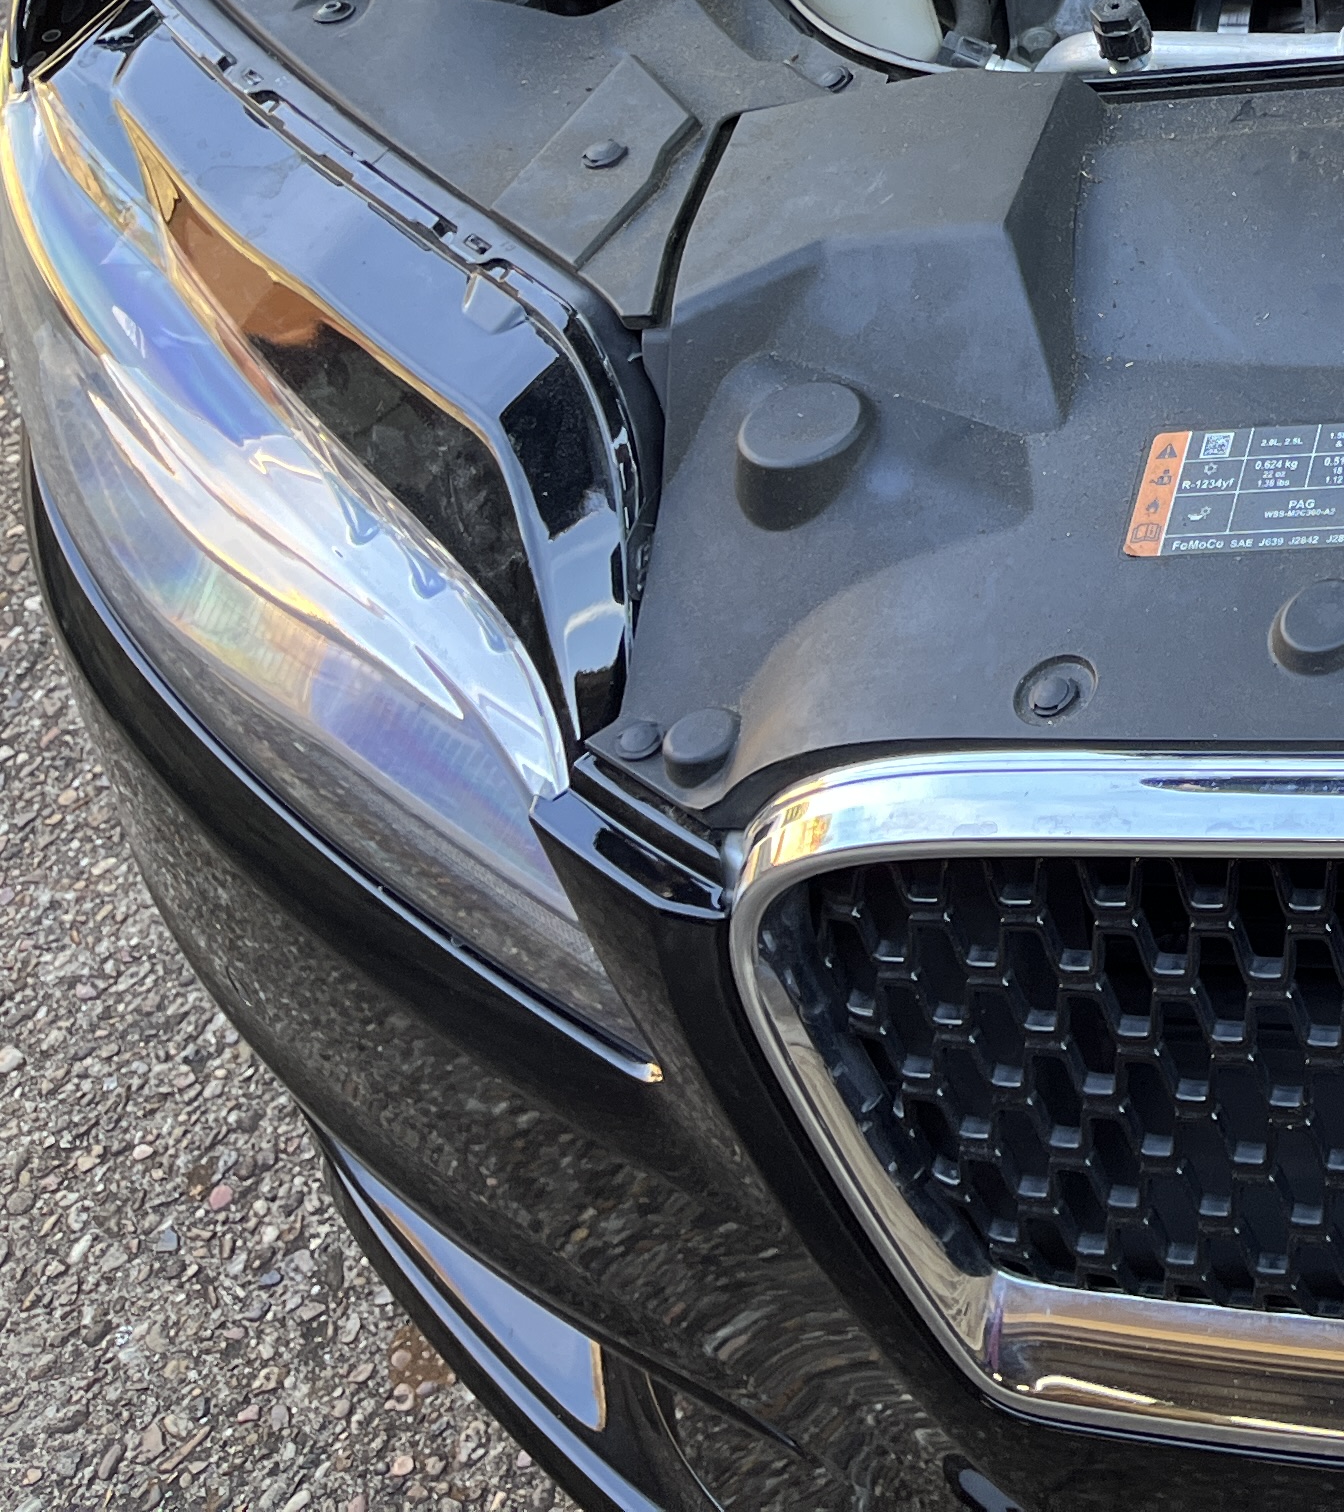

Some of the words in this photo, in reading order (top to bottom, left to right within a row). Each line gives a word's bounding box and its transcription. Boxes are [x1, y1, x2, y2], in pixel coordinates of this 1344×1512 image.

[1335, 440, 1343, 448] &
[1254, 459, 1282, 470] 0.624
[1284, 459, 1299, 471] kg
[1262, 470, 1274, 479] 22
[1275, 470, 1286, 478] oz
[1332, 466, 1343, 475] 18
[1277, 478, 1290, 487] lbs
[1325, 475, 1343, 484] 1.12
[1181, 478, 1235, 491] R-1234yf
[1288, 498, 1316, 509] PAG
[1171, 538, 1225, 552] FoMoCo
[1229, 538, 1254, 549] SAE
[1258, 536, 1285, 548] J639
[1288, 535, 1320, 545] J2842
